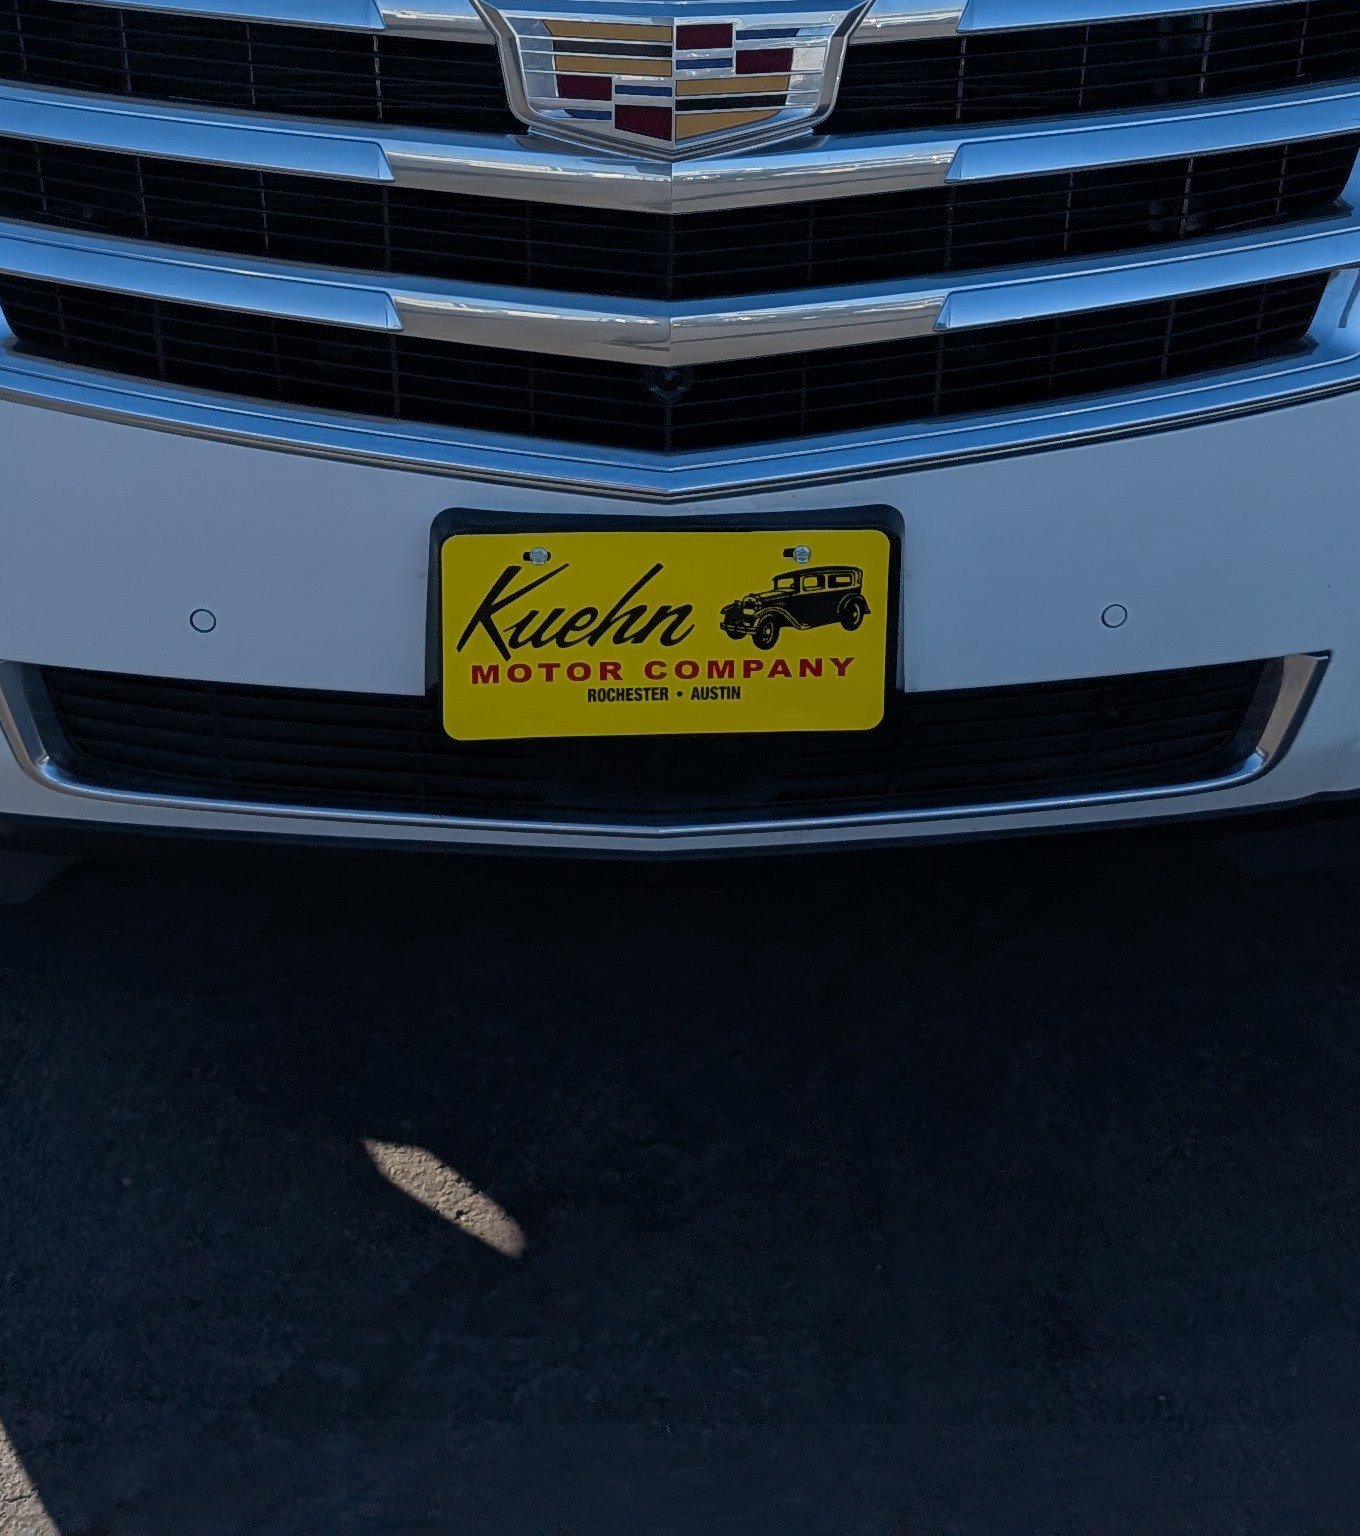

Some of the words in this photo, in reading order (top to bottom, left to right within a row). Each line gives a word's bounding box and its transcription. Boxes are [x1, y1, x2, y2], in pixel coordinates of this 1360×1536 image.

[456, 563, 695, 662] Kuehn
[471, 661, 623, 684] MOTOR
[644, 657, 855, 680] COMPANY
[587, 686, 669, 702] ROCHESTER
[690, 686, 741, 701] AUSTIN
